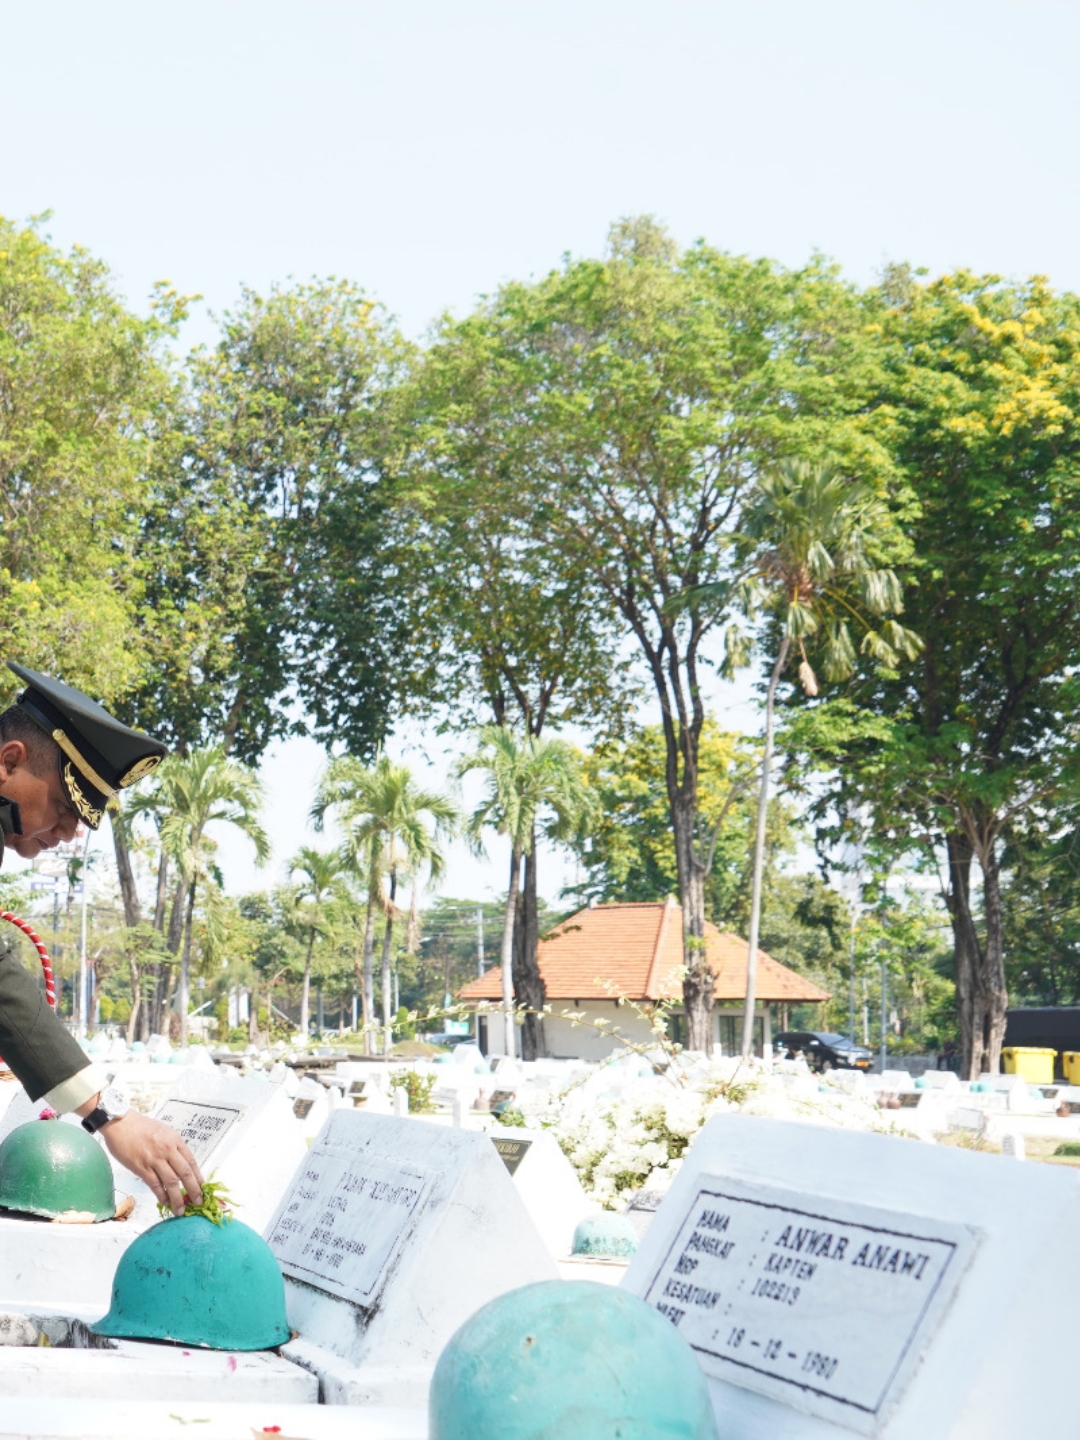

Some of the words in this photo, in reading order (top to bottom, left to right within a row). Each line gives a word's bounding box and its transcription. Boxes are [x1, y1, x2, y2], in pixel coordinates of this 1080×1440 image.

[684, 1230, 736, 1261] PANGKAT
[764, 1252, 818, 1281] KAPTEN
[697, 1209, 731, 1233] NAMA
[775, 1224, 850, 1261] ANWAR
[852, 1242, 930, 1281] ANAWI
[662, 1277, 721, 1309] KESATUAN
[763, 1338, 783, 1360] 12
